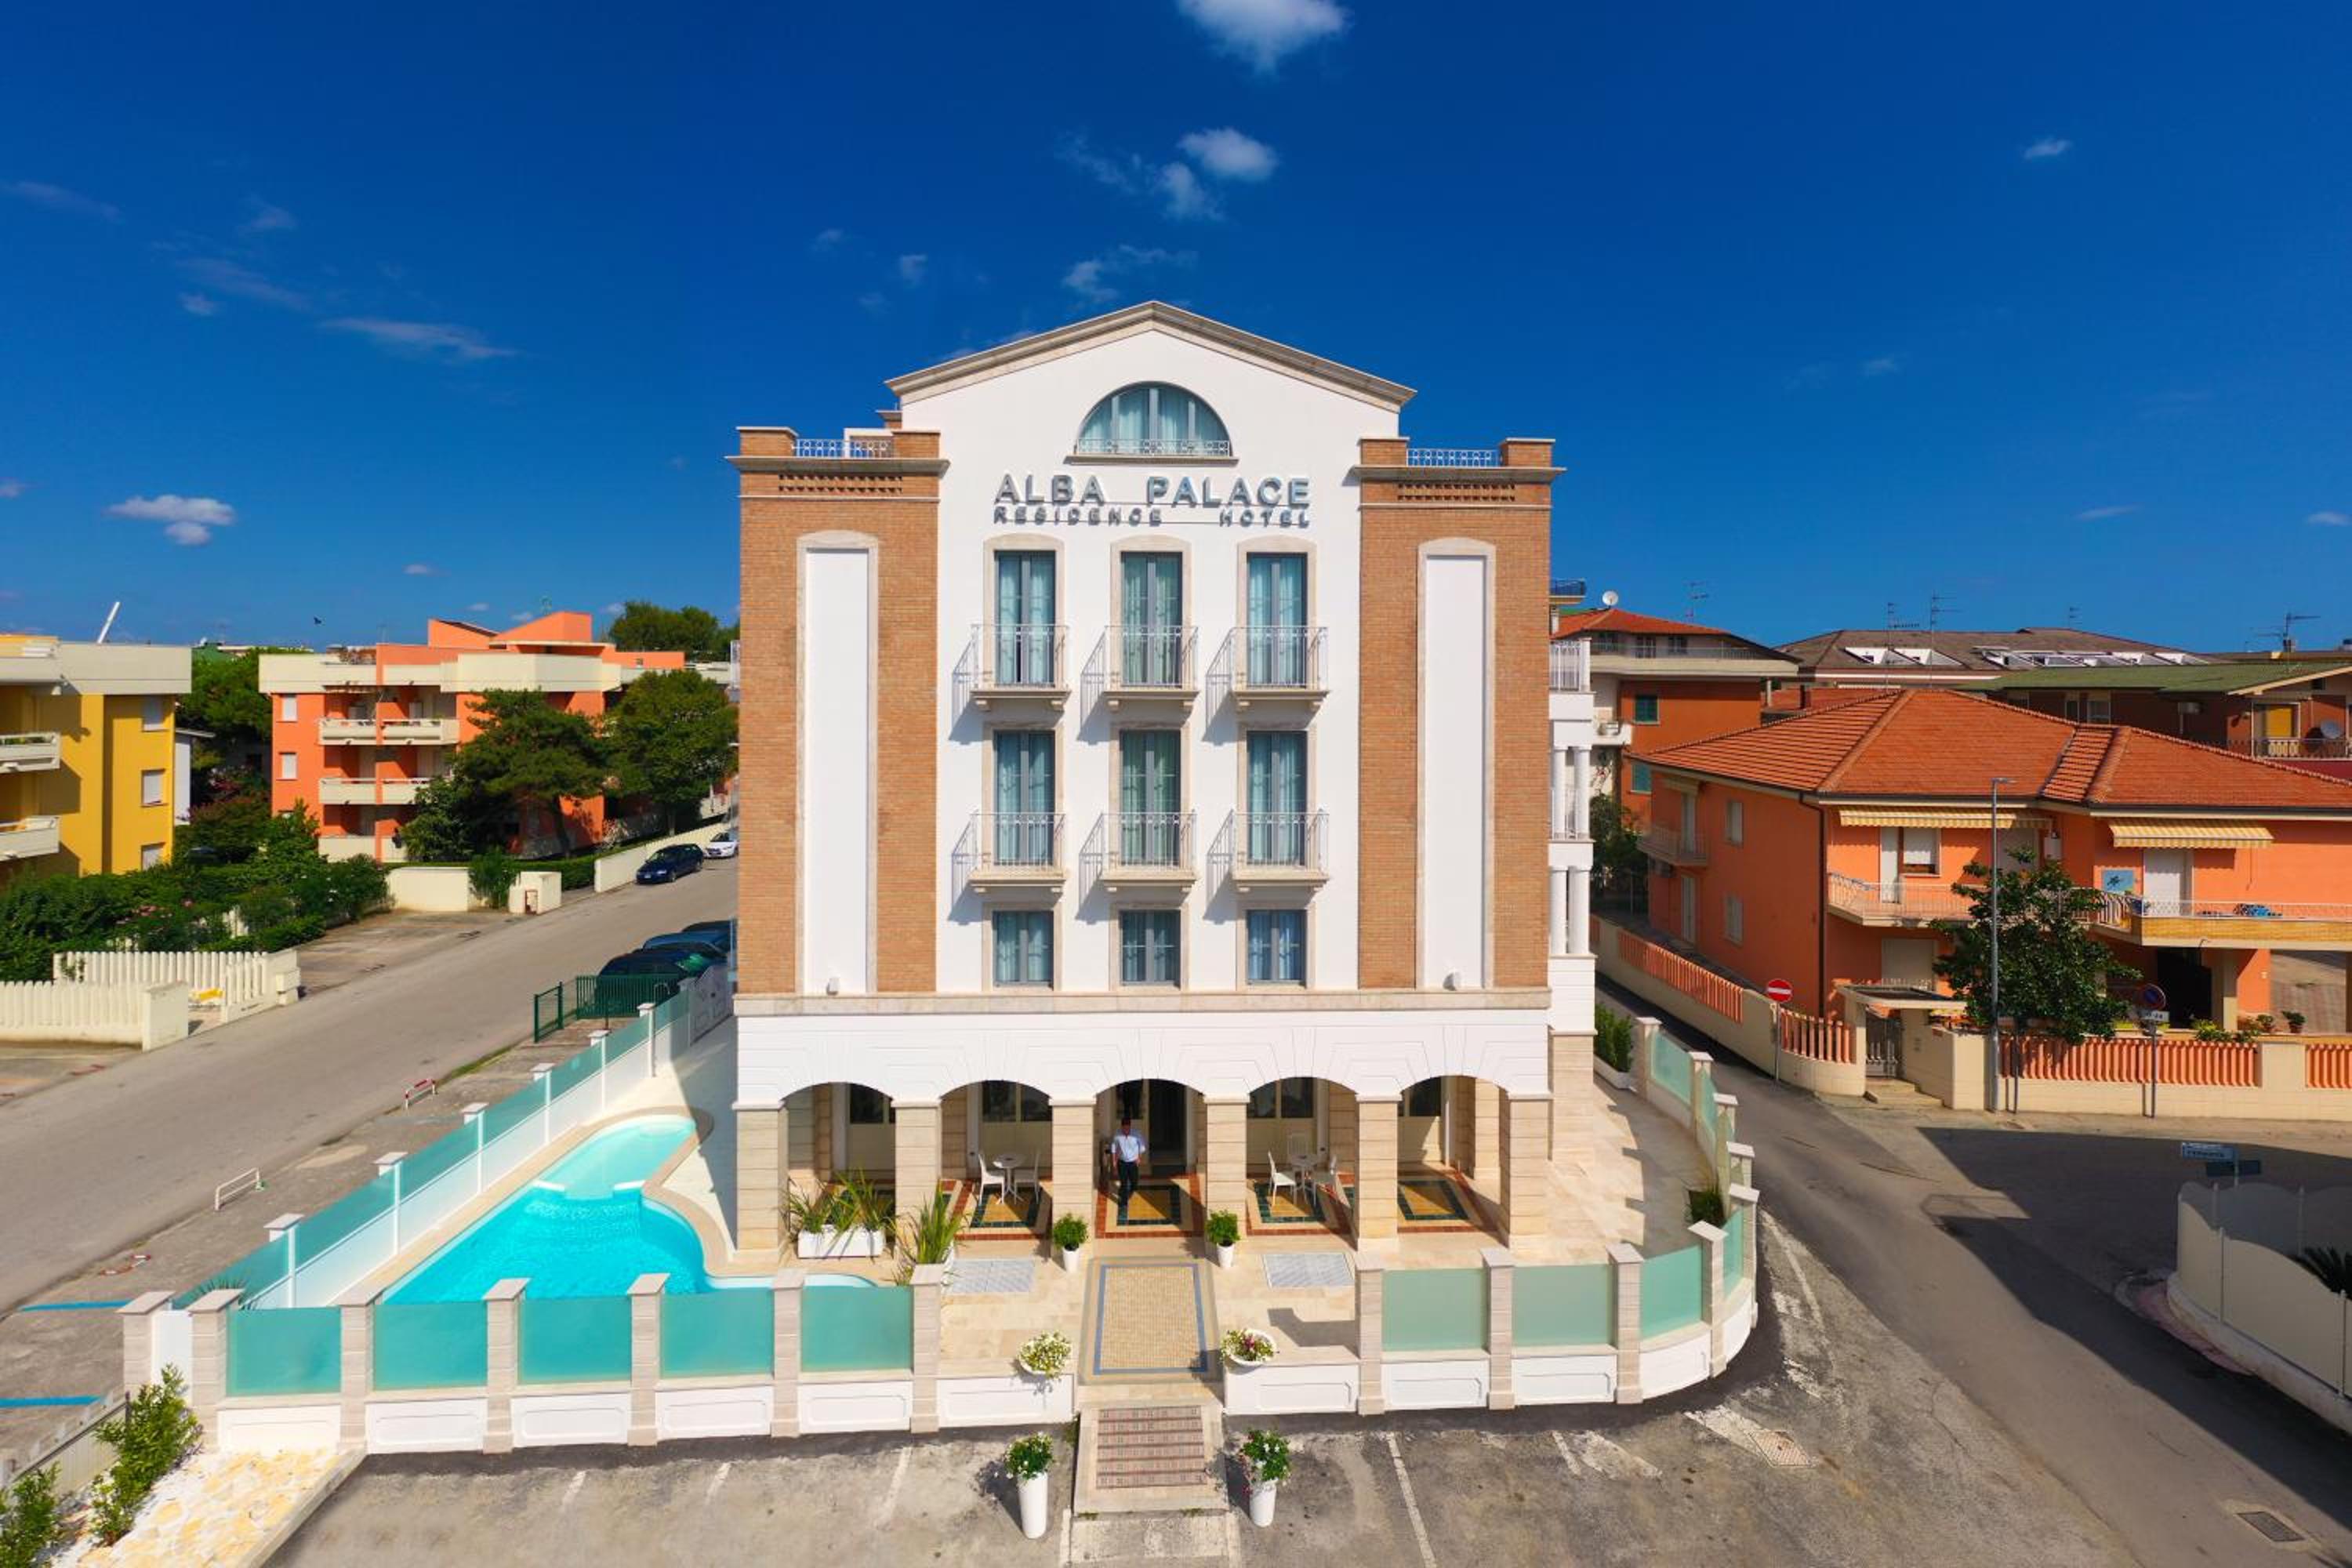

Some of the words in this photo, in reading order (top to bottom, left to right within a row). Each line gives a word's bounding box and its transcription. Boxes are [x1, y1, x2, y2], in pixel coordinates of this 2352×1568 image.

[994, 474, 1105, 506] ALBA
[1147, 476, 1310, 509] PALACE
[993, 506, 1161, 526] RESIDENCE
[1219, 509, 1309, 528] HOTEL
